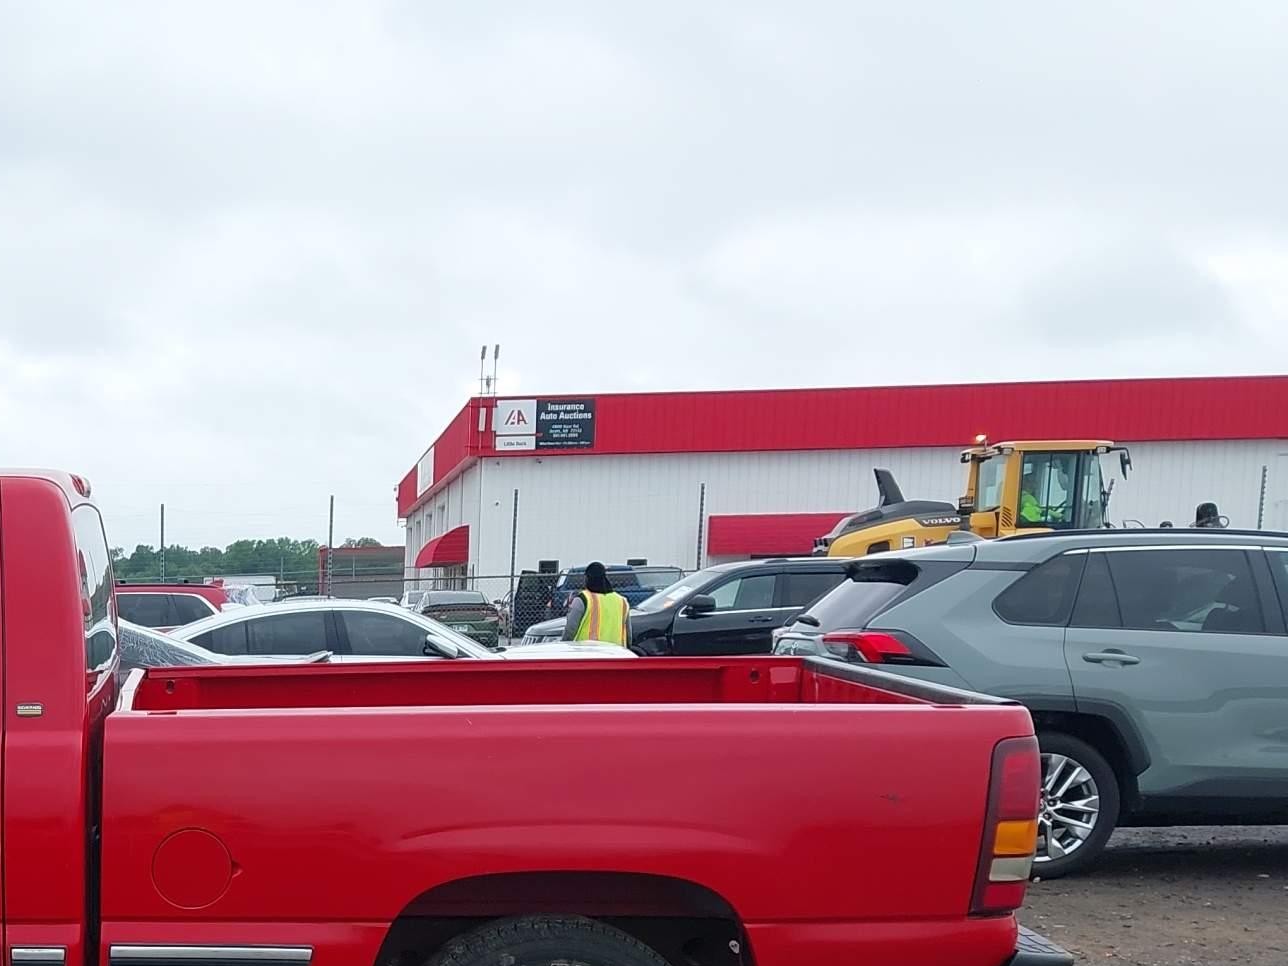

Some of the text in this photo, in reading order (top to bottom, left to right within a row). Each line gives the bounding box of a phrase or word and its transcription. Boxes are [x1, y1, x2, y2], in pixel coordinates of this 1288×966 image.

[548, 403, 585, 411] Insurance
[539, 411, 592, 420] Auto Auctions
